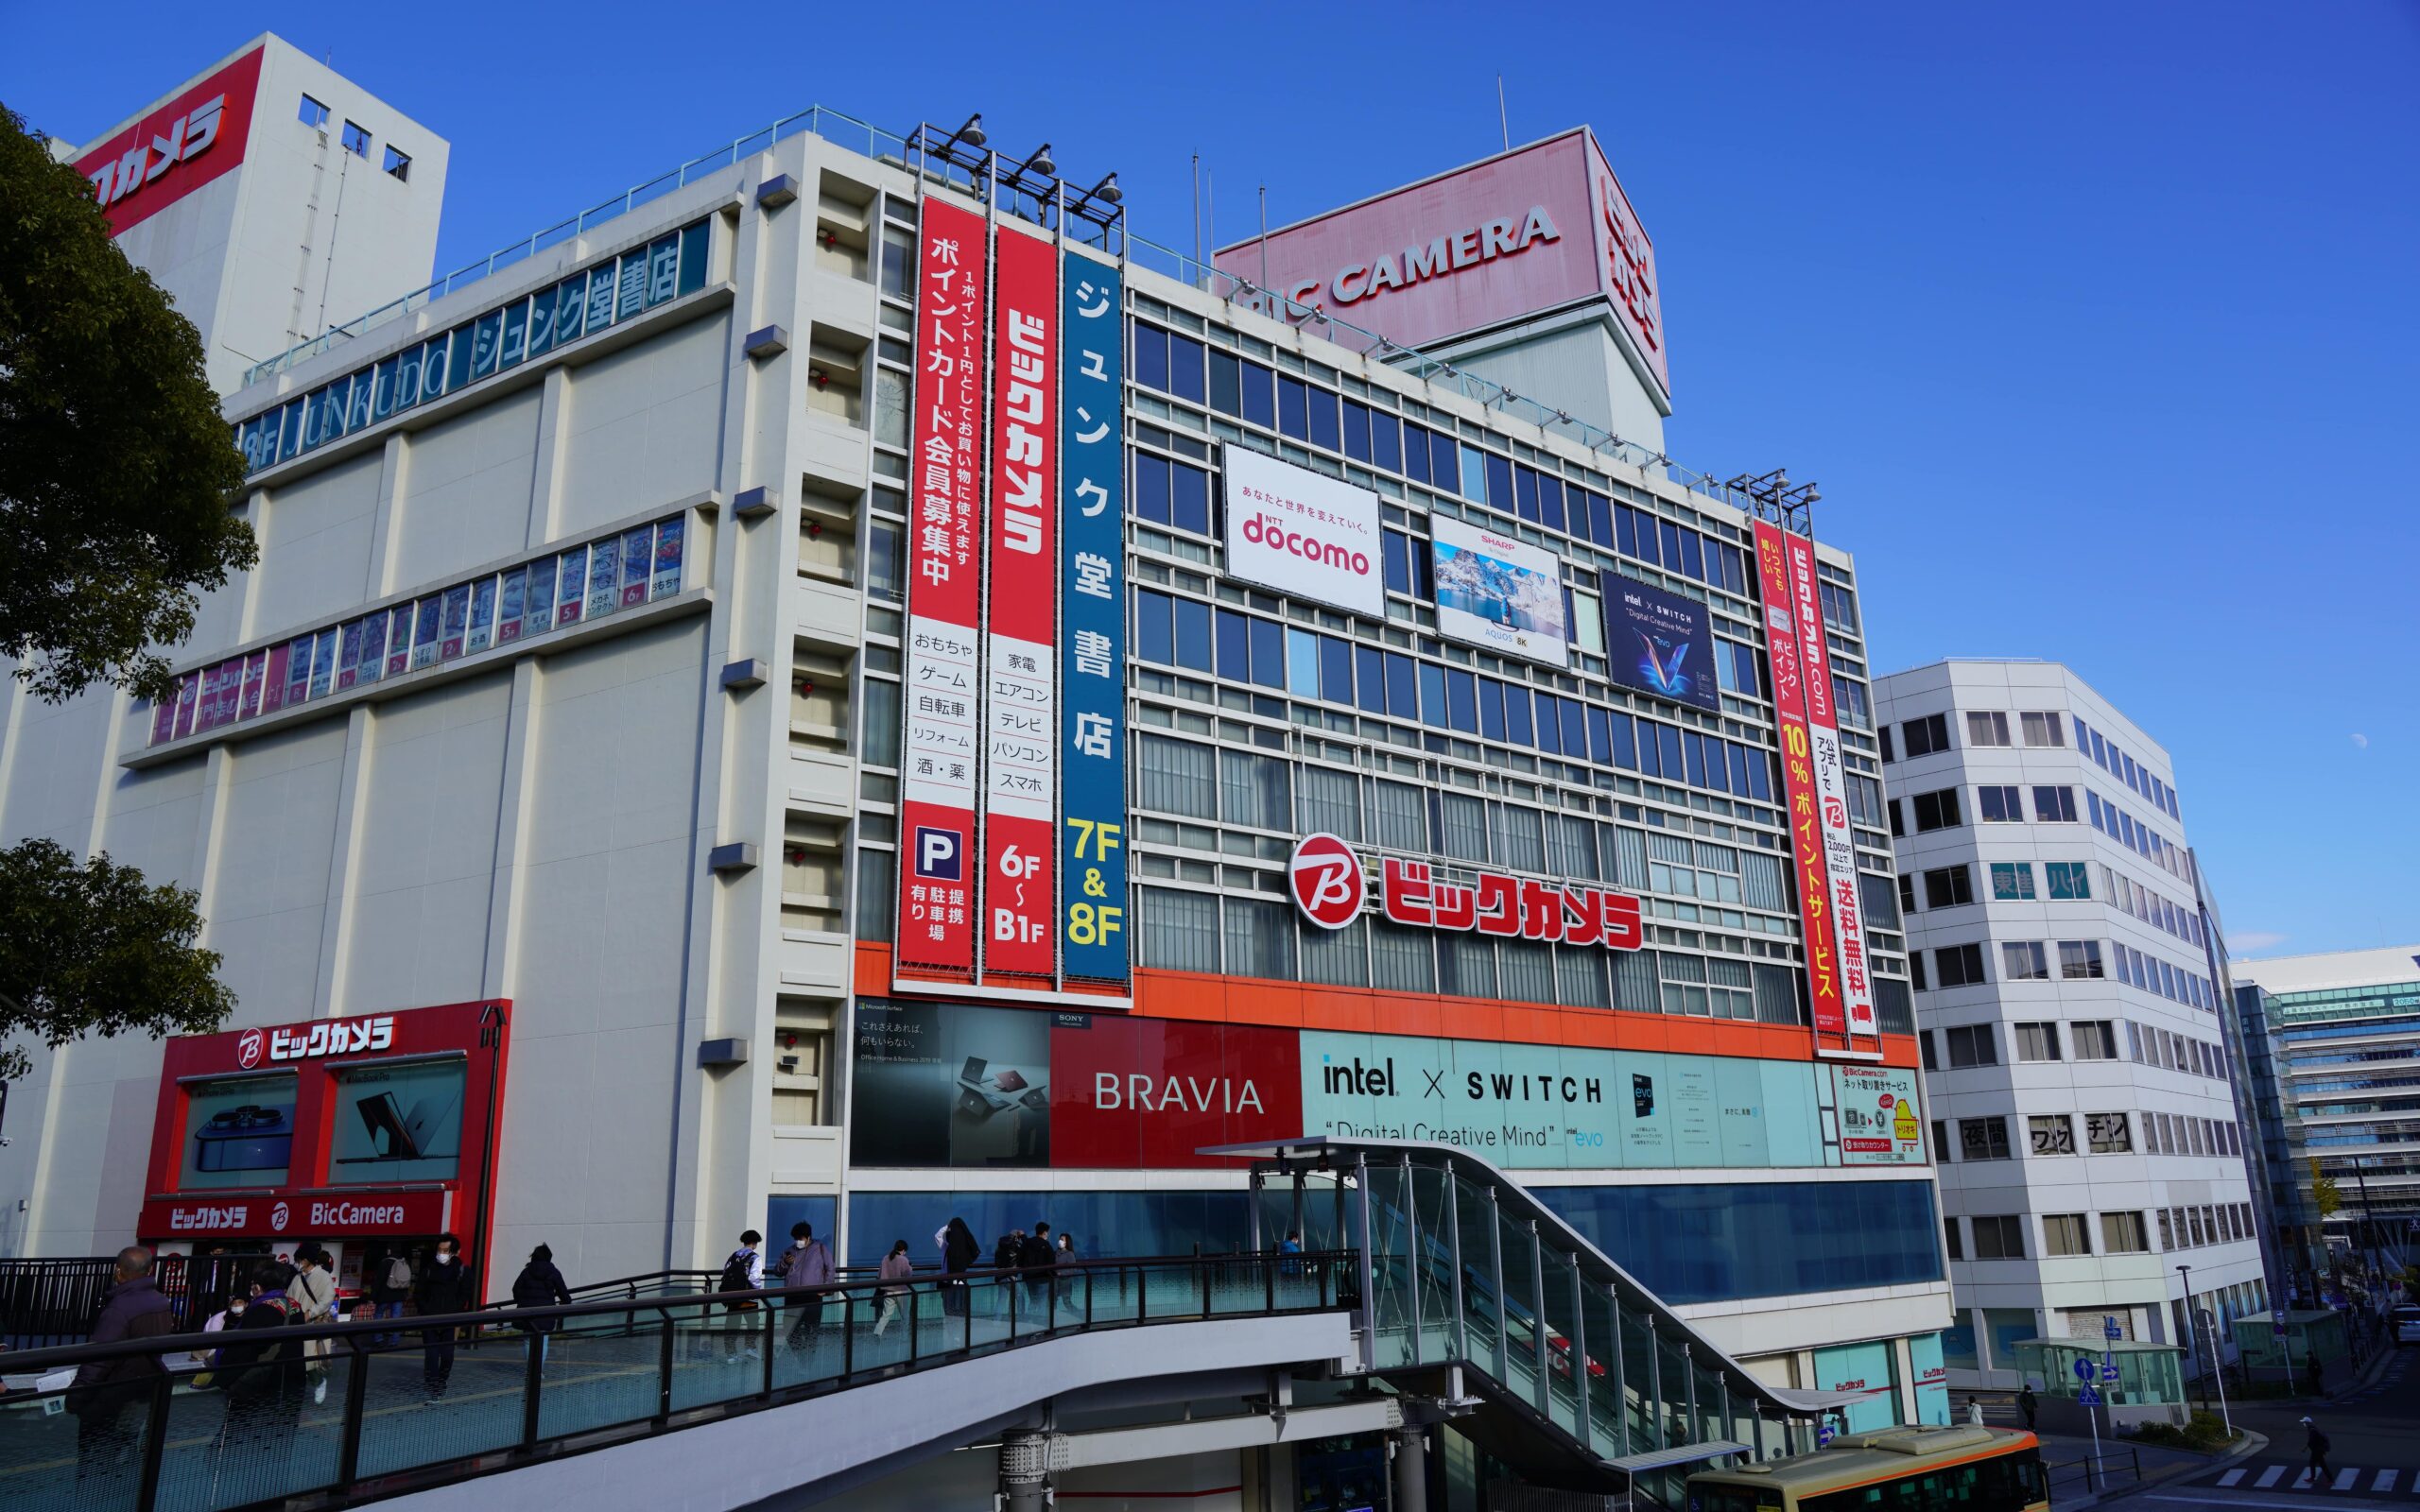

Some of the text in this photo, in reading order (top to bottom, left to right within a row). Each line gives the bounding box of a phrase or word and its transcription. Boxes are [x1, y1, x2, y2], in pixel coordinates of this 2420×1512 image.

[90, 94, 225, 206] クカメラ
[1333, 204, 1560, 303] CAMERA
[287, 349, 447, 455] JUNKUDO
[476, 247, 678, 374] ジュンク堂書店
[922, 237, 959, 587] ポイントカード会員募集中
[1004, 308, 1045, 556] ビックカメラ
[1074, 280, 1113, 759] ジュンク堂書店
[1242, 486, 1368, 535] あなたと世界を変えていく。
[1266, 515, 1283, 526] NTT
[1243, 512, 1369, 576] docomo
[1481, 535, 1514, 550] SHARP
[1771, 542, 1784, 592] いつでも
[628, 588, 641, 602] 6F
[1624, 592, 1642, 606] intel
[1656, 605, 1692, 624] SWITCH
[1485, 628, 1527, 647] AQUOS 8K
[1650, 616, 1675, 630] Creative
[914, 632, 973, 657] おもちゃ
[919, 665, 968, 690] ゲーム
[1008, 654, 1037, 674] 家電
[1772, 638, 1789, 701] ポイント
[1784, 641, 1797, 687] ビック
[919, 695, 966, 718] 自転車
[994, 680, 1049, 704] エアコン
[914, 727, 970, 747] リフォーム
[1001, 713, 1042, 733] テレビ
[993, 741, 1049, 764] パソコン
[1817, 736, 1832, 791] アプリで
[917, 757, 965, 782] 酒・薬
[1000, 772, 1042, 794] スマホ
[923, 833, 954, 872] P
[1066, 817, 1121, 862] 7F
[999, 844, 1040, 880] 6F
[1083, 868, 1108, 898] &
[910, 885, 926, 921] 有り
[928, 885, 945, 941] 駐車場
[948, 887, 964, 924] 提携
[1382, 855, 1643, 953] ビックカメラ
[994, 908, 1044, 944] B1F
[1067, 902, 1123, 947] 8F
[1836, 878, 1866, 998] 送料無料
[861, 1021, 924, 1035] これさえあれば、
[1059, 1014, 1083, 1022] SONY
[270, 1016, 394, 1060] ビックカメラ
[860, 1036, 915, 1049] 何もいらない。
[1095, 1072, 1264, 1115] BRAVIA
[1323, 1055, 1394, 1096] intel
[1467, 1070, 1601, 1105] SWITCH
[1635, 1087, 1651, 1098] evo
[1844, 1078, 1908, 1091] ネット取り置きサービス
[1414, 1123, 1496, 1146] Creative
[1575, 1131, 1603, 1146] evo
[1896, 1124, 1915, 1135] トリオキ
[171, 1206, 247, 1229] ビックカメラ
[311, 1202, 404, 1226] BicCamera
[1836, 1379, 1865, 1391] ビックカメラ
